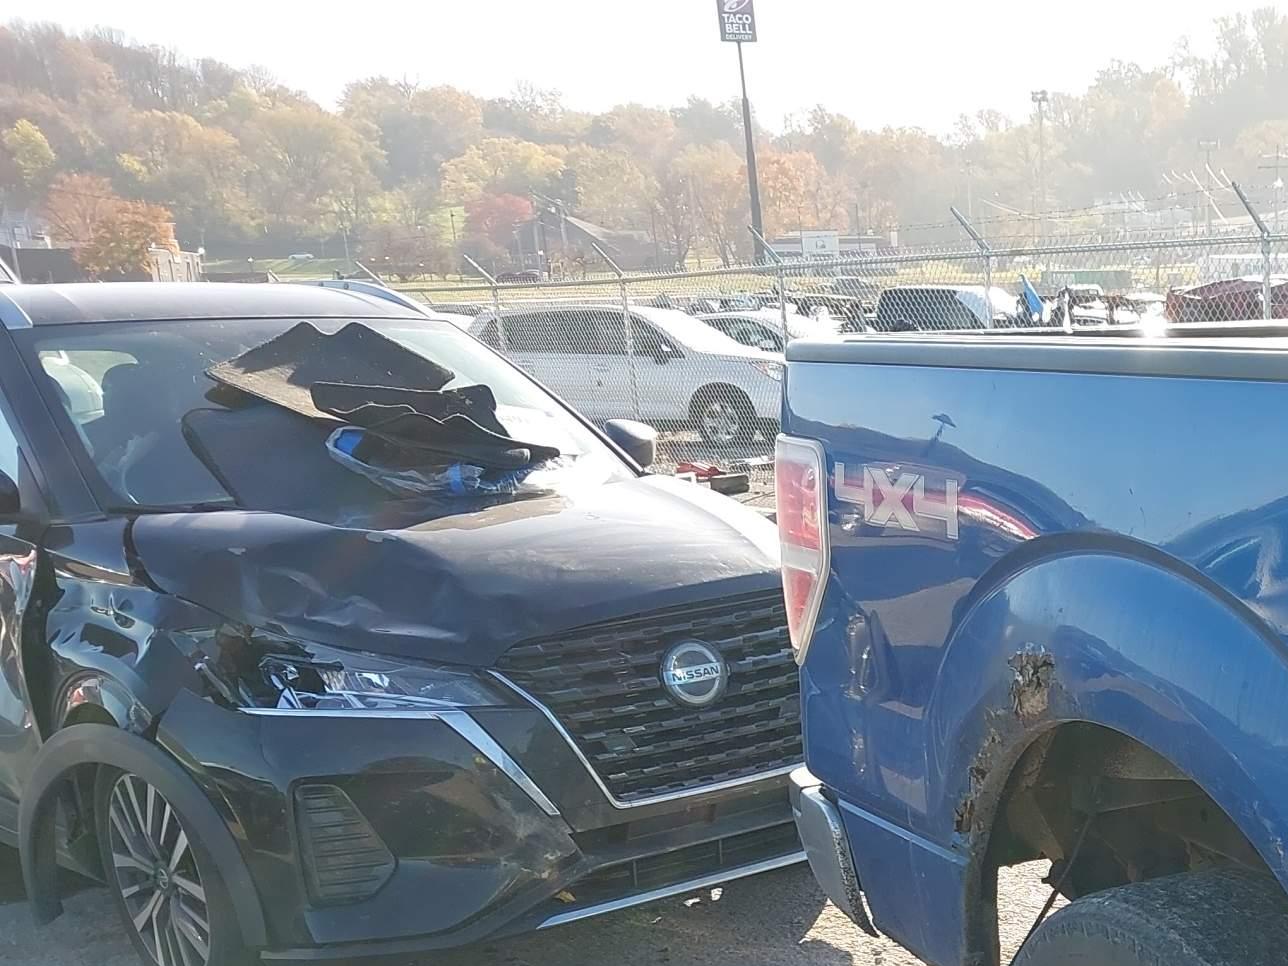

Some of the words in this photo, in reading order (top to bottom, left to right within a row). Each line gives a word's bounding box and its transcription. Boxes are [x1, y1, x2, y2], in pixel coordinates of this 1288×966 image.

[722, 13, 752, 24] TACO
[725, 23, 753, 34] BELL
[672, 665, 719, 682] NISSAN
